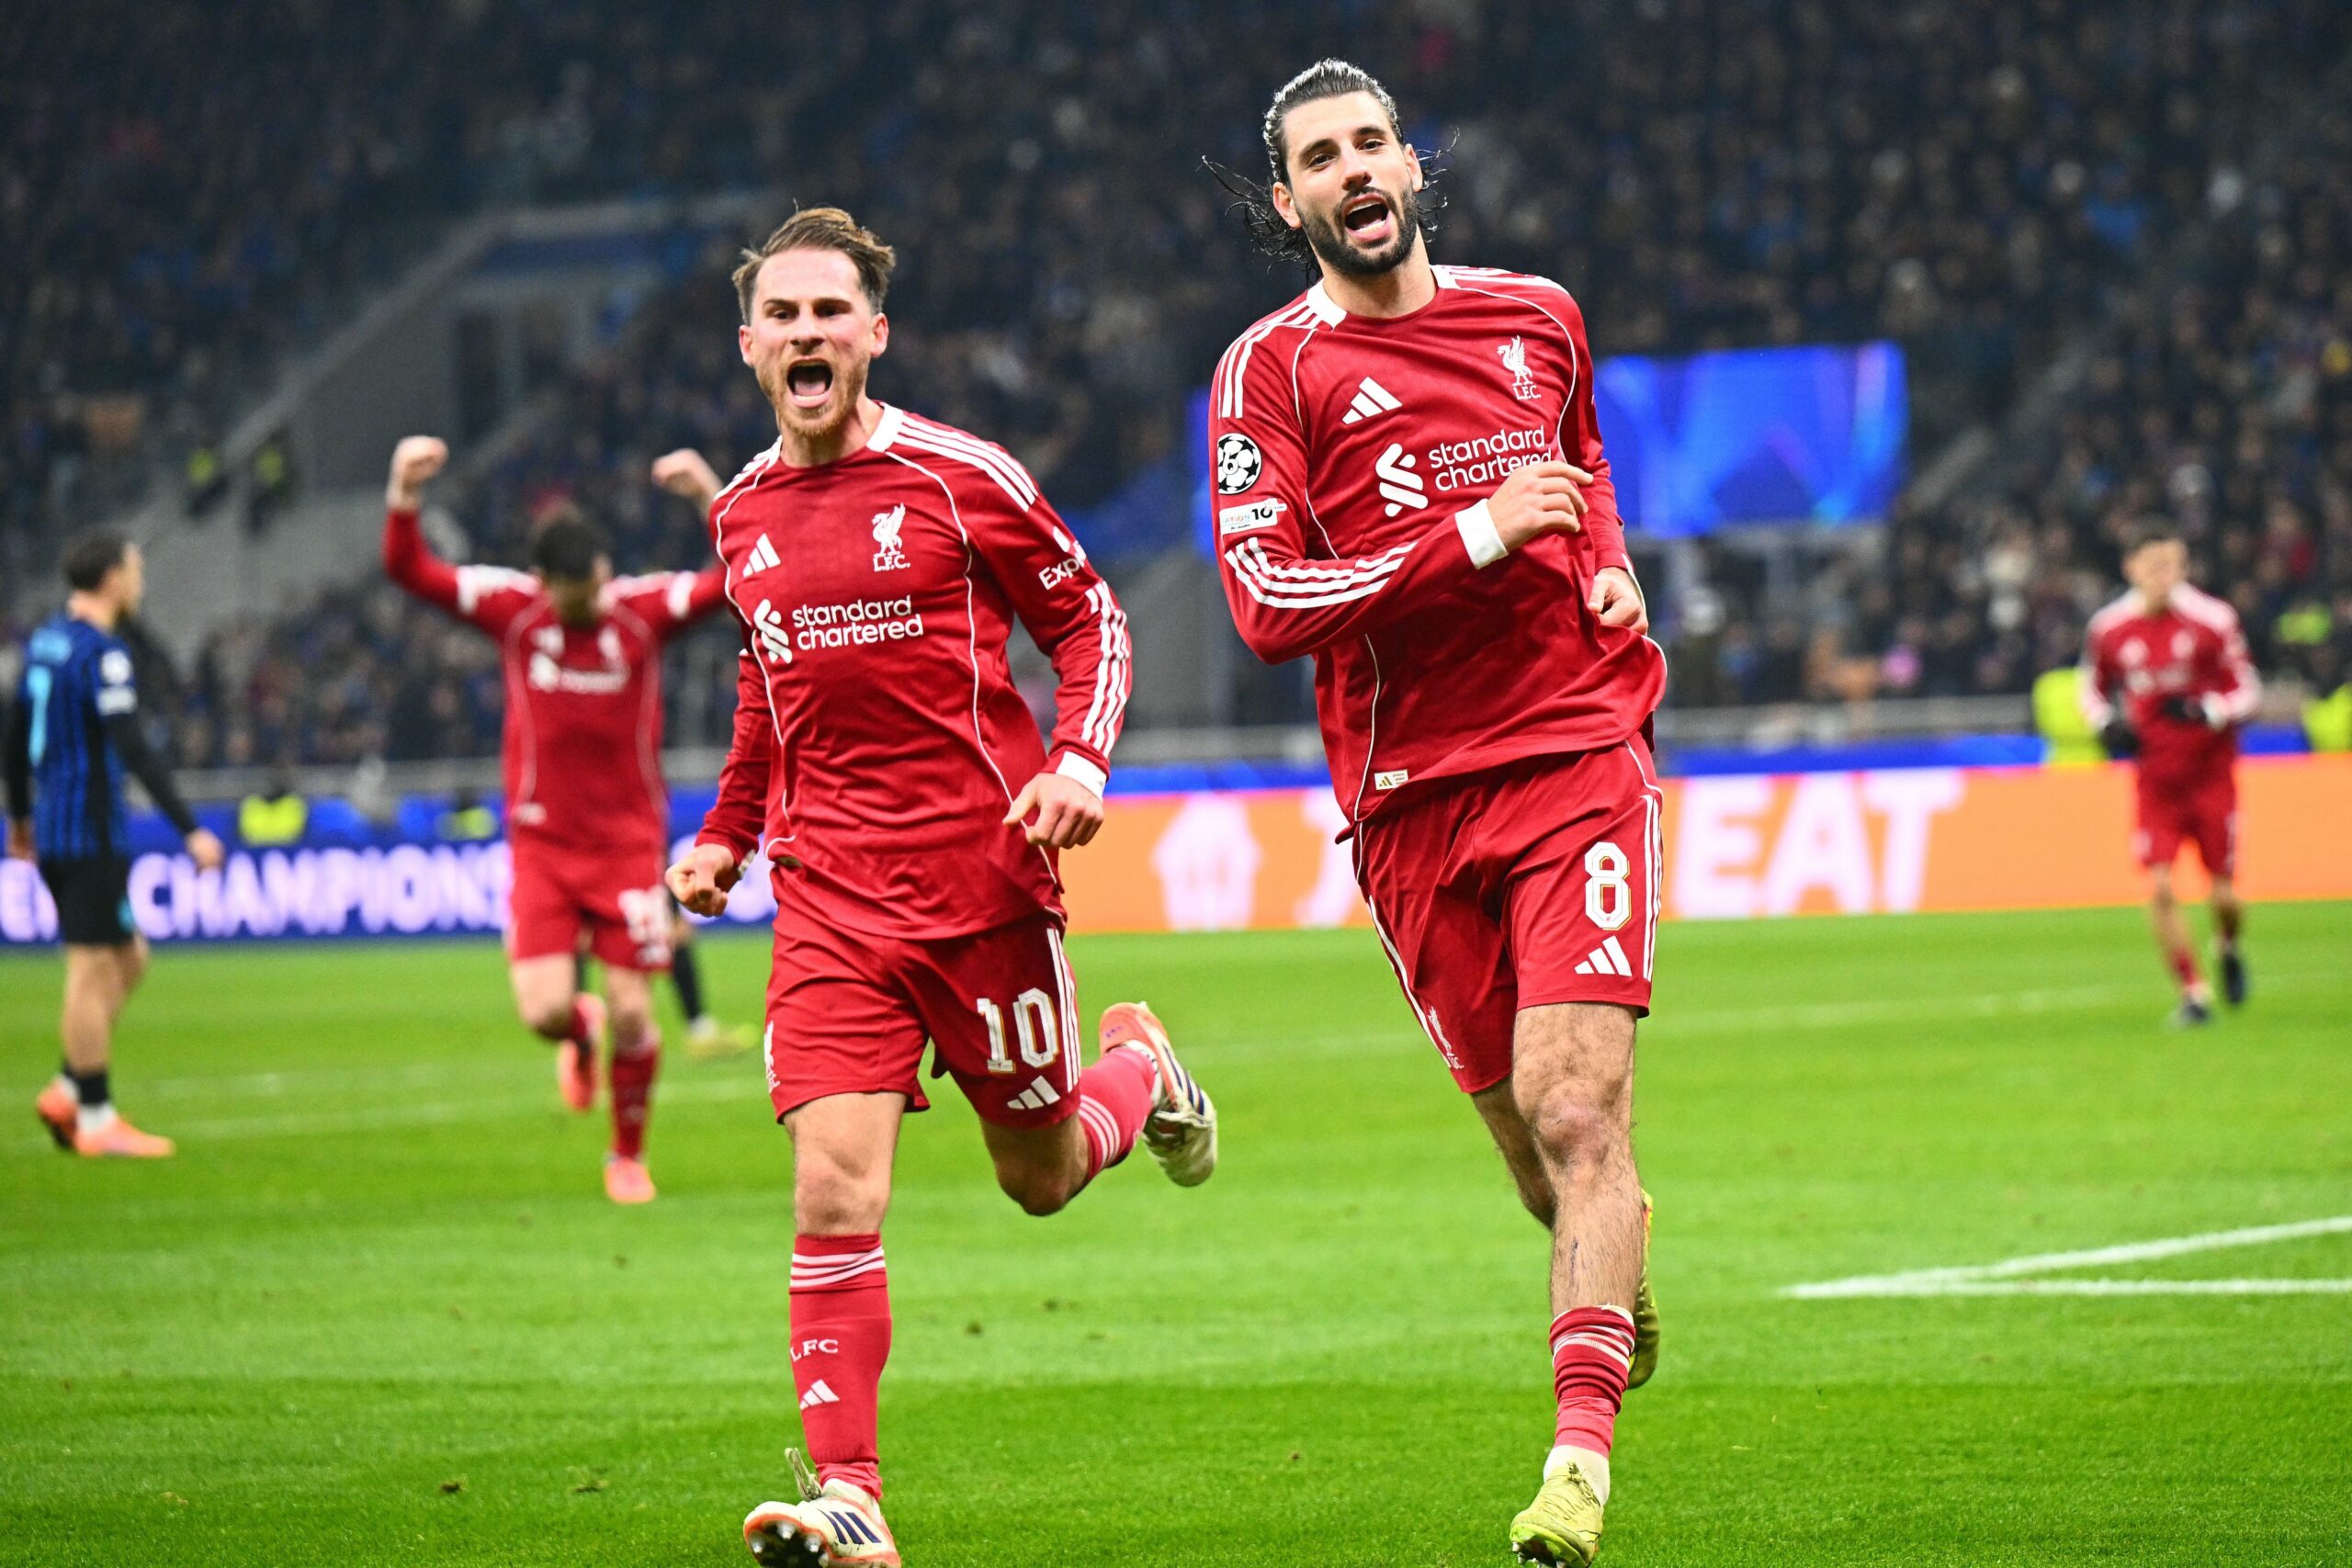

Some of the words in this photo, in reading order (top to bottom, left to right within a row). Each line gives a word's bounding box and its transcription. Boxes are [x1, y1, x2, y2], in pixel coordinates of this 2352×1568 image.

[1428, 424, 1545, 468] standard
[1435, 447, 1552, 491] chartered
[1038, 547, 1086, 591] Exp
[792, 594, 912, 628] standard
[797, 613, 924, 650] chartered
[1672, 767, 1964, 920] EAT
[1584, 840, 1632, 931] 8
[976, 987, 1060, 1074] 10
[789, 1338, 839, 1363] LFC
